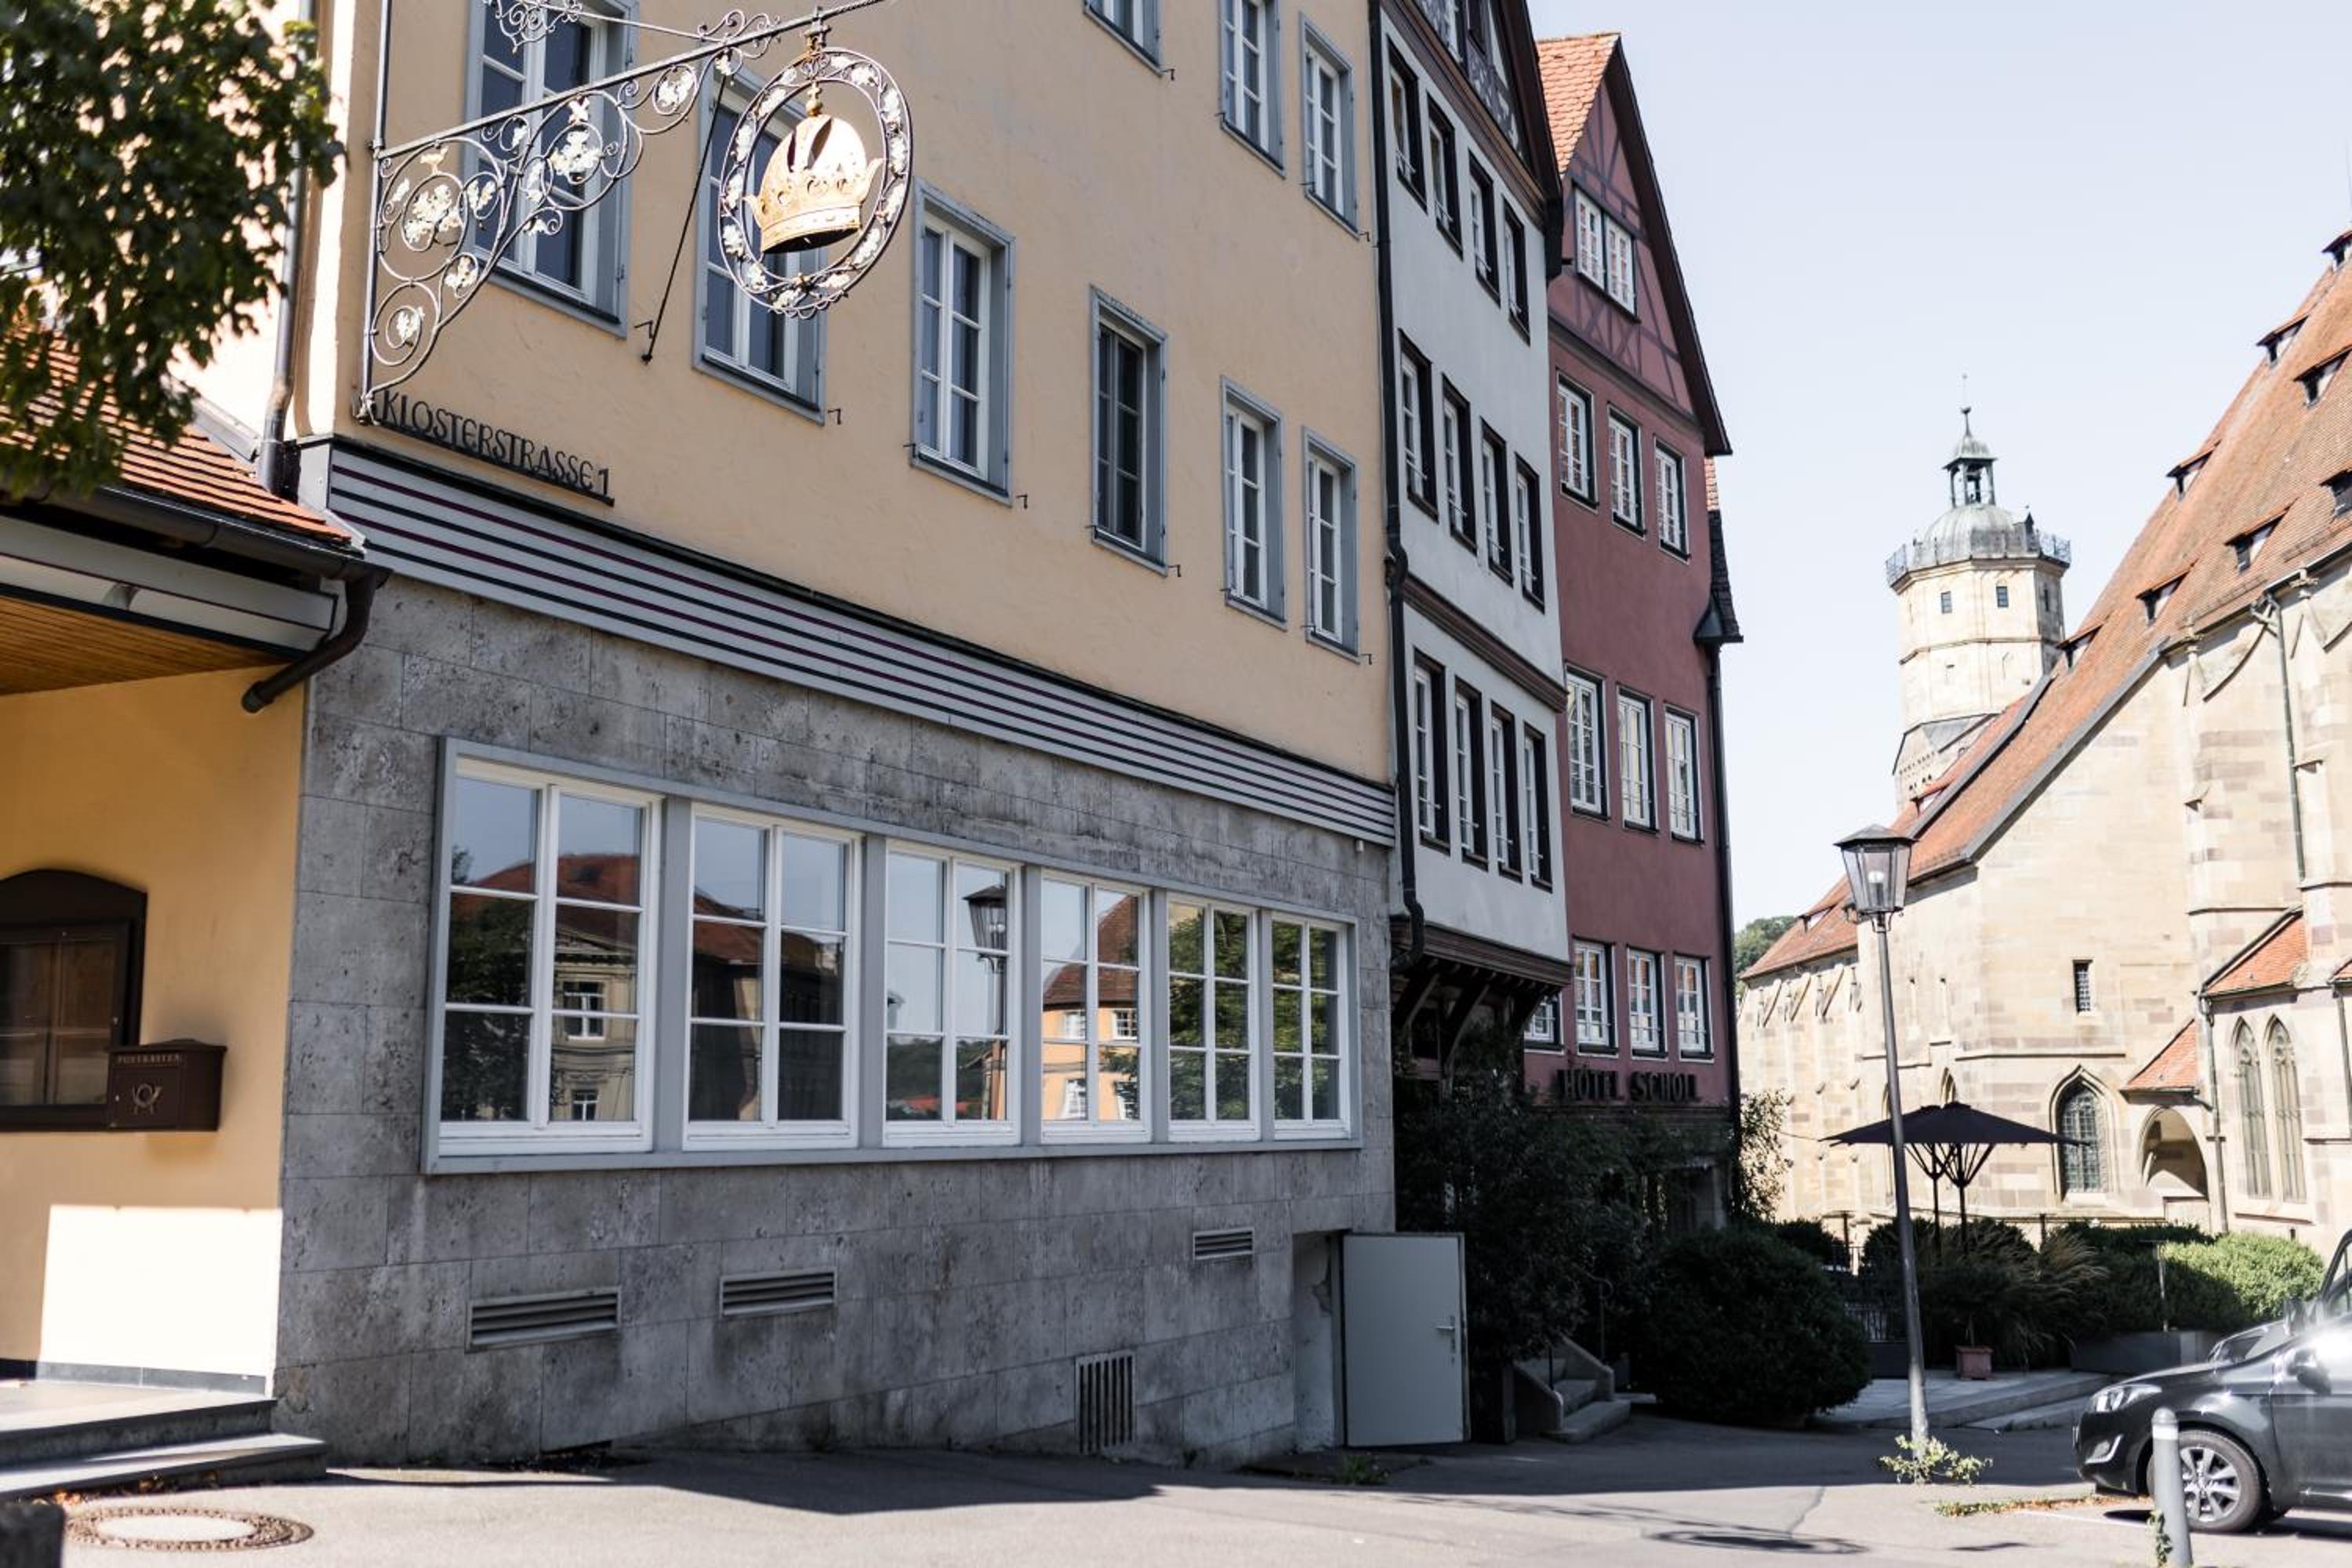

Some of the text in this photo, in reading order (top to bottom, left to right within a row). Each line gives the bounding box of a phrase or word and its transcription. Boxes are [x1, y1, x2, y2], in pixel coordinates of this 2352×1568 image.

[381, 390, 610, 495] KLOSTERSTRASSE 1
[1560, 1069, 1624, 1101] HOTEL
